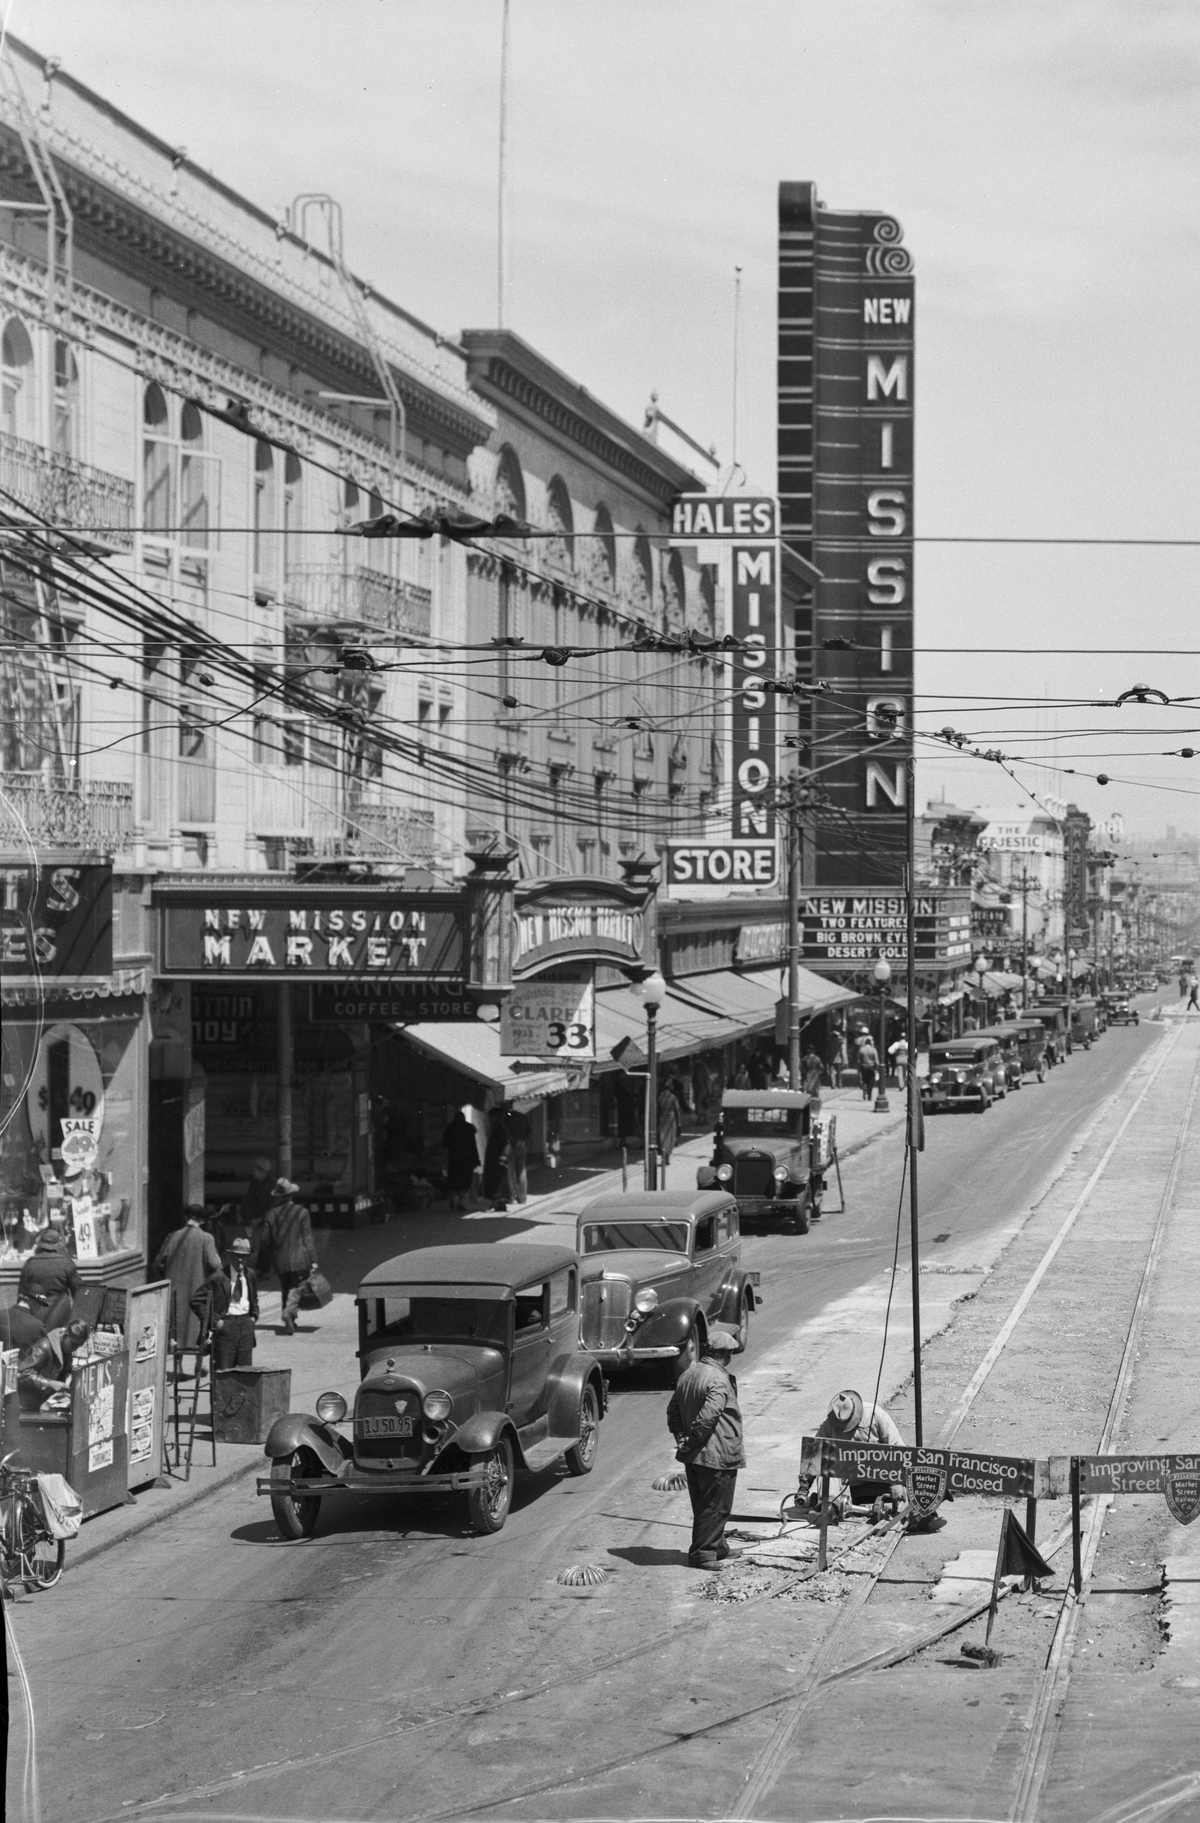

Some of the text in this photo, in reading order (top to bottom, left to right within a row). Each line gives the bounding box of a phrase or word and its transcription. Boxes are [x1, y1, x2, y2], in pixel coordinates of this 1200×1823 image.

[864, 298, 911, 324] NEW
[673, 503, 772, 534] HALES
[866, 354, 907, 806] MISSION
[738, 551, 771, 834] MISSION
[674, 850, 772, 880] STORE
[805, 899, 932, 915] NEW MISSIN
[205, 909, 426, 931] NEW MISSION
[519, 897, 633, 956] NEW MISSION MARKET
[820, 917, 846, 928] TWO
[816, 932, 836, 943] BIG
[841, 932, 882, 943] BROWN
[204, 935, 427, 966] MARKET
[827, 947, 873, 958] DESERT
[334, 1002, 472, 1016] COFFEE STORE
[508, 1004, 588, 1022] CLARET
[65, 1121, 94, 1134] SALE
[81, 1360, 111, 1399] NEWS
[838, 1447, 1018, 1479] Improving San Francisco
[1089, 1456, 1170, 1477] Improving
[857, 1463, 1003, 1492] Street Closed
[915, 1474, 937, 1483] Market
[916, 1481, 936, 1490] Street
[1111, 1477, 1161, 1491] Street
[1175, 1480, 1198, 1488] Market
[1176, 1488, 1197, 1496] Street
